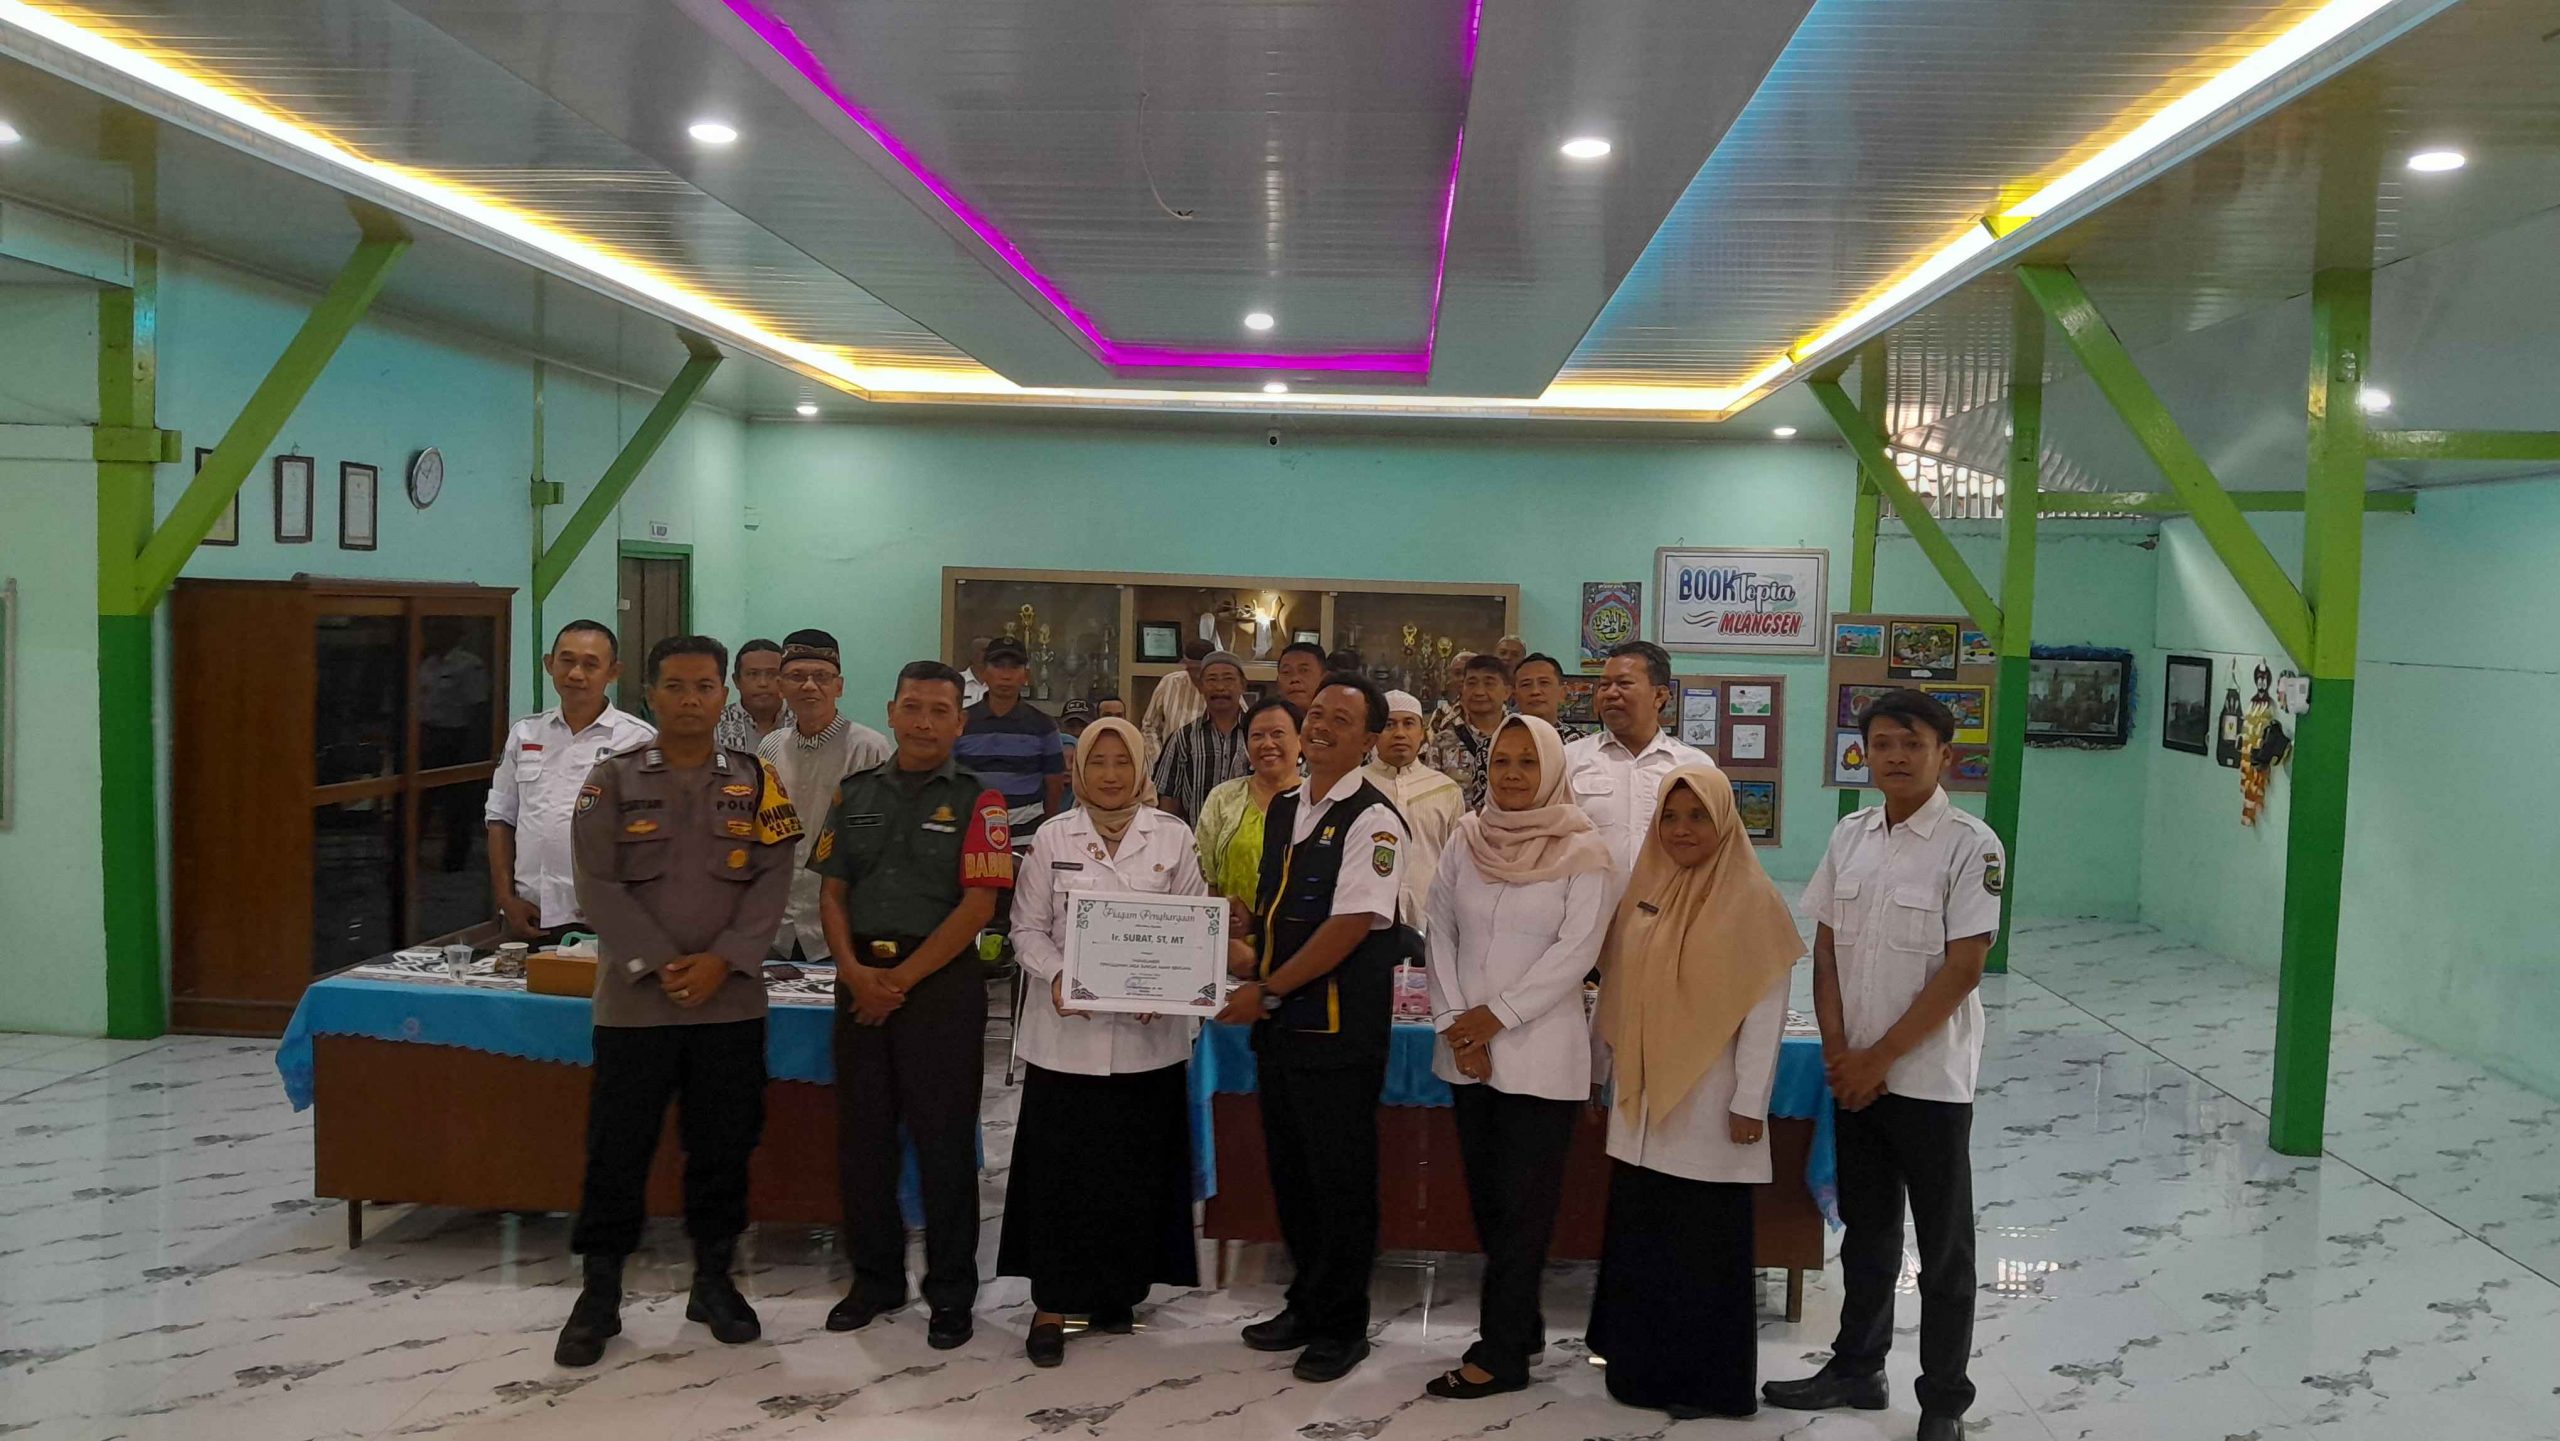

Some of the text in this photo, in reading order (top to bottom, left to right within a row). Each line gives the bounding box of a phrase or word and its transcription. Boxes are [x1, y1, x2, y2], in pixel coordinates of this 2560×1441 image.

[1718, 610, 1804, 637] MLANGSEN
[1103, 906, 1195, 925] Piagam Penghargaan
[1111, 932, 1185, 945] Ir. SURAT, ST, MT
